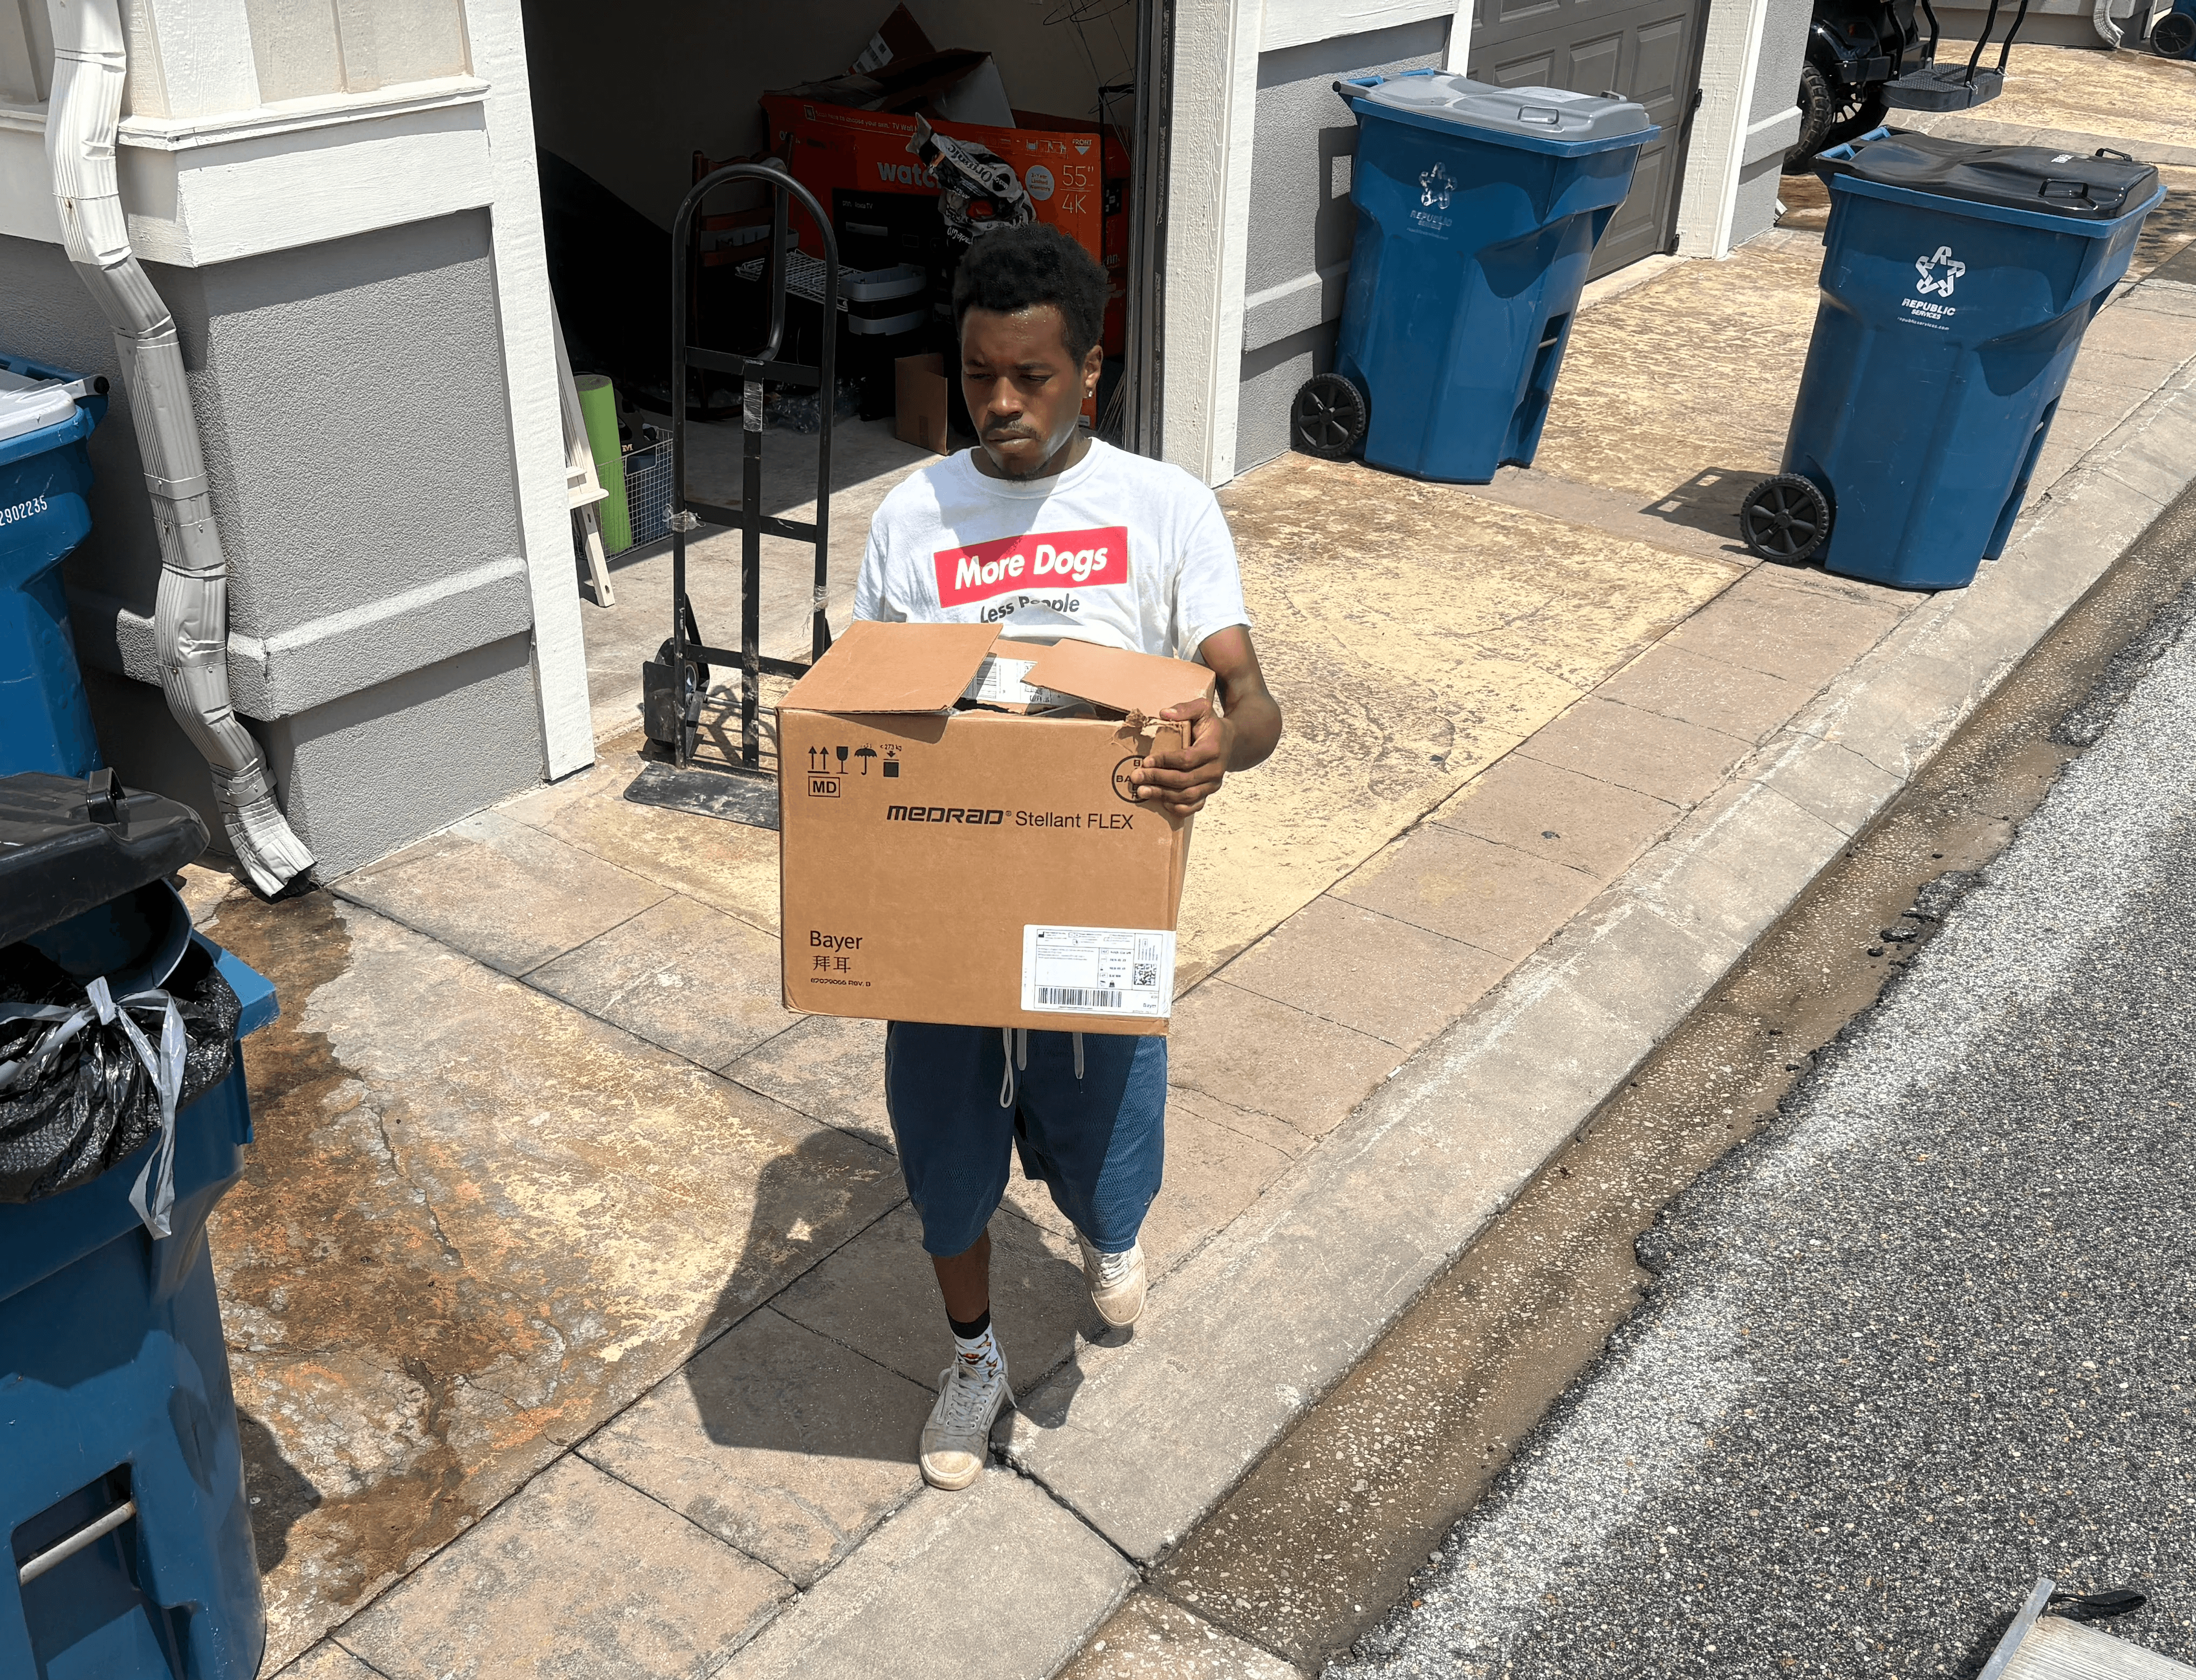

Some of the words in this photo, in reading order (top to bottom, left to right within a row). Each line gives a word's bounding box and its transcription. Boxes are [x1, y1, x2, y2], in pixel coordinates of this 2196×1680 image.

[947, 144, 993, 182] Organic
[1062, 194, 1086, 214] 4K
[1901, 298, 1956, 316] REPUBLIC
[1911, 309, 1942, 320] SERVICES
[955, 553, 1025, 591] More
[1033, 544, 1108, 582] Dogs
[980, 601, 1015, 623] Less
[813, 780, 837, 793] MD
[1015, 811, 1082, 828] Stellant
[1087, 813, 1134, 829] FLEX
[810, 930, 863, 953] Bayer
[812, 955, 851, 973] 拜耳
